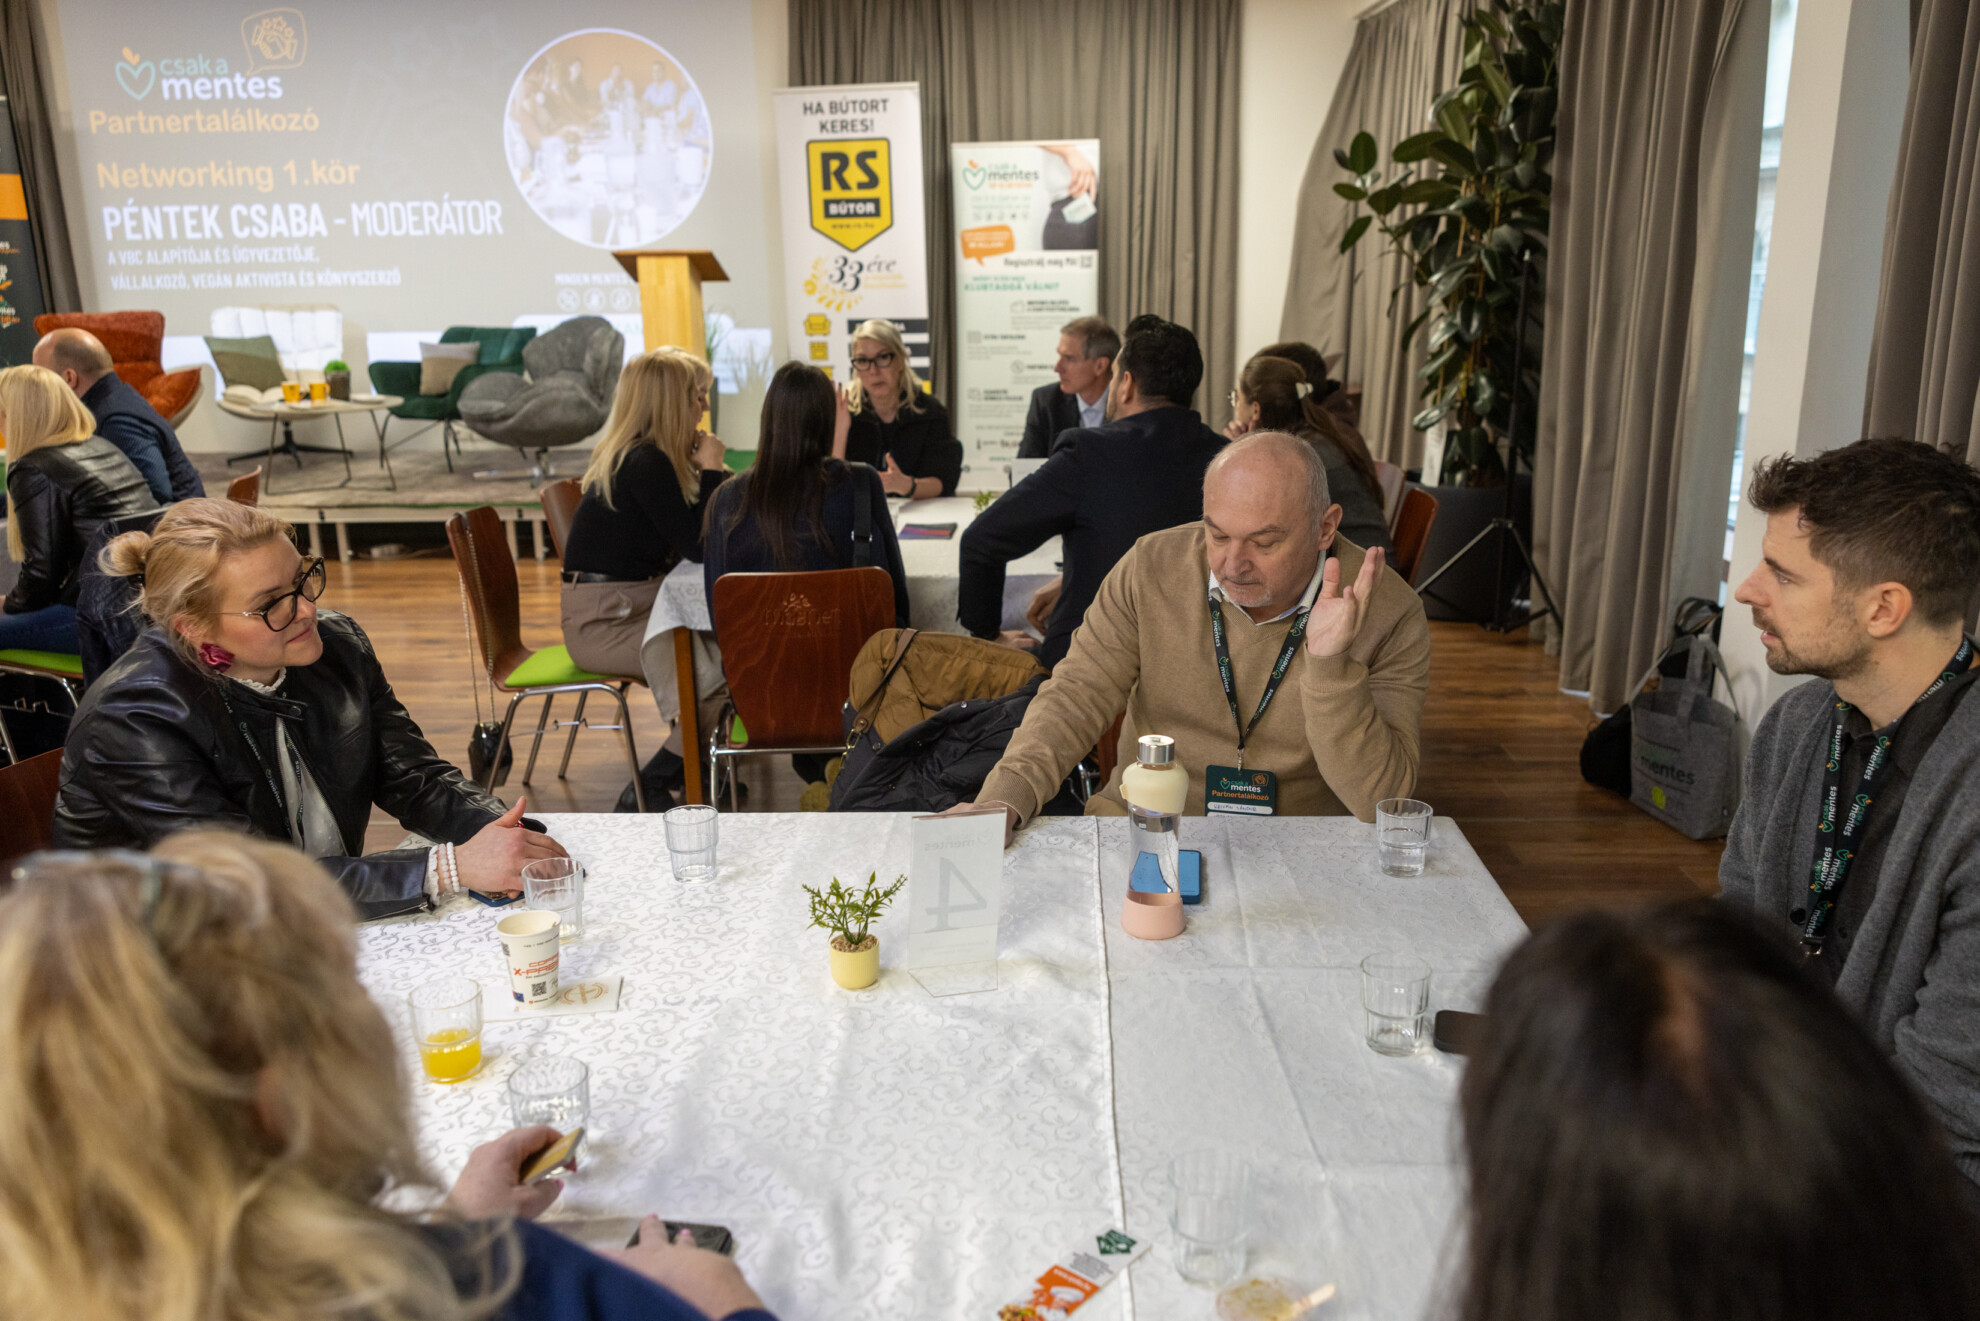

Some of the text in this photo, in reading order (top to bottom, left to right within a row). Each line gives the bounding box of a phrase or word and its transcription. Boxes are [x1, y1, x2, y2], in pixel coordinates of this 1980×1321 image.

[160, 53, 229, 76] csak a
[161, 71, 284, 101] mentes
[89, 106, 320, 135] Partnertalálkozó
[803, 96, 889, 116] HA BÚTORT
[819, 118, 874, 134] KERES!
[97, 158, 361, 192] Networking 1.kör
[820, 150, 880, 191] RS
[988, 169, 1040, 181] mentes
[102, 197, 224, 241] PÉNTEK
[230, 202, 329, 239] CSABA
[350, 192, 504, 237] MODERÁTOR
[828, 200, 876, 215] BÚTOR
[108, 250, 117, 266] A
[146, 245, 213, 265] ALAPÍTÓJA
[214, 245, 230, 264] ÉS
[191, 269, 233, 289] VEGÁN
[235, 271, 297, 288] AKTIVISTA
[298, 268, 315, 288] ÉS
[828, 255, 864, 292] 33
[866, 254, 897, 273] éve
[1213, 620, 1221, 647] mentes
[1279, 646, 1294, 673] mentes
[1220, 666, 1230, 693] mentes
[1834, 724, 1843, 760] mentes
[1640, 756, 1695, 785] mentes
[1863, 745, 1881, 781] mentes
[1211, 789, 1270, 801] Partnertalálkozó
[1230, 785, 1262, 793] mentes
[1828, 785, 1837, 821] mentes
[1843, 803, 1860, 837] mentes
[1820, 846, 1832, 881] mentes
[1824, 858, 1840, 890] mentes
[1805, 909, 1820, 938] mentes
